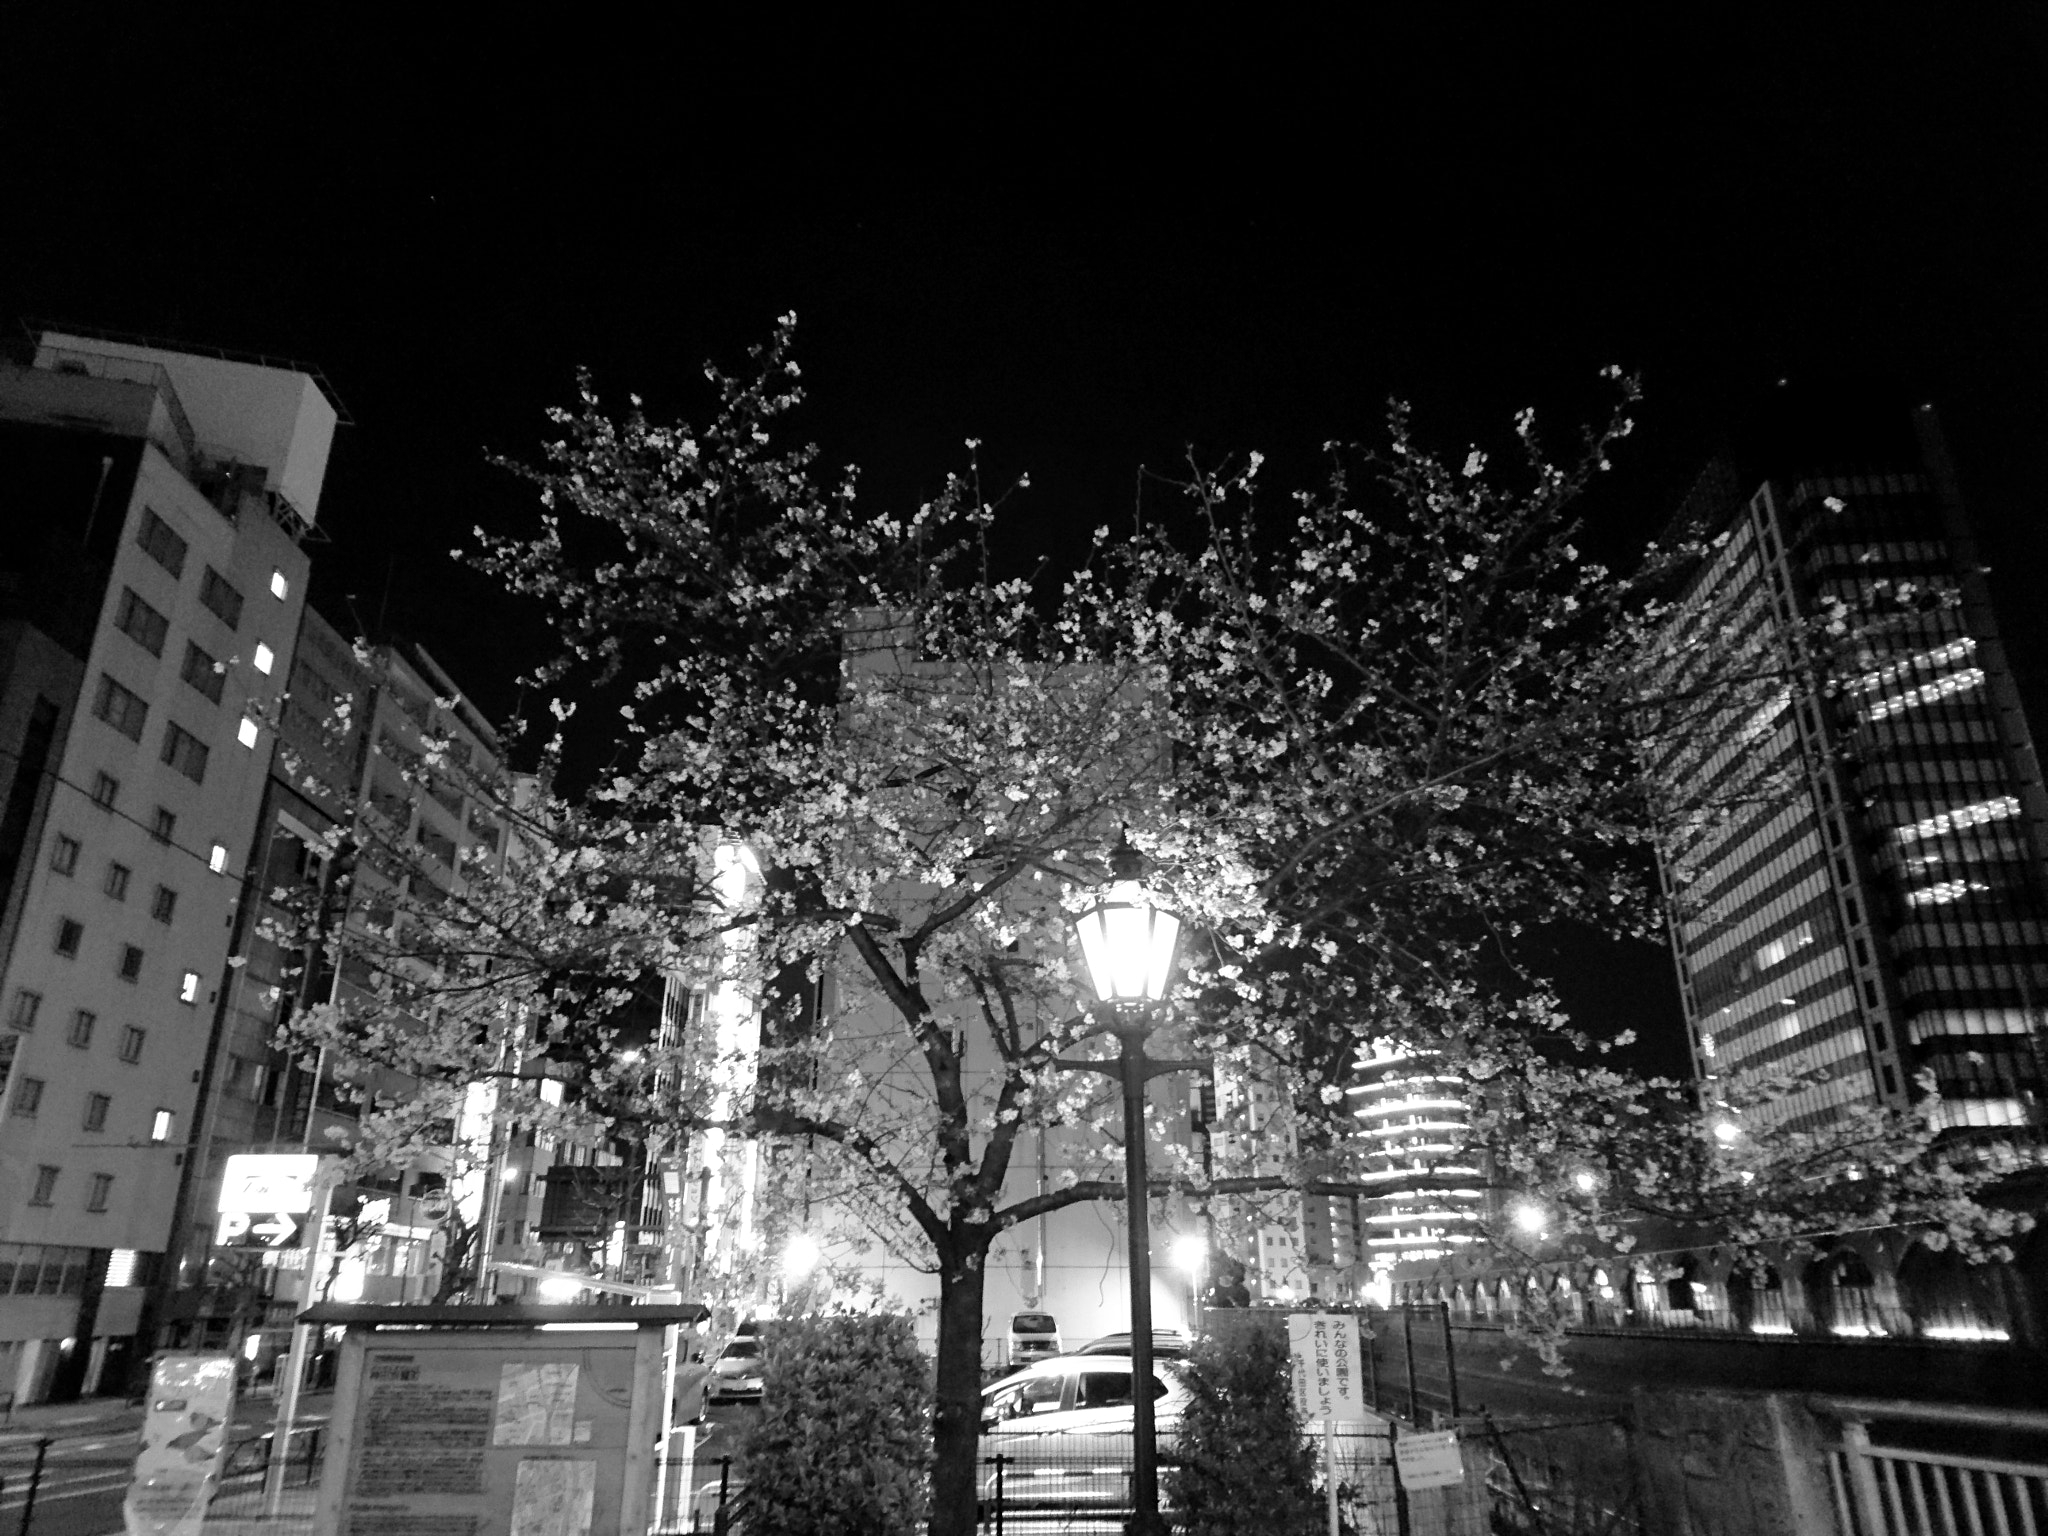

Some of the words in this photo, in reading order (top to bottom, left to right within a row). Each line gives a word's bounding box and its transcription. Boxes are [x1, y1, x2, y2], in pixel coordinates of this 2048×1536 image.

[215, 1212, 251, 1246] P
[1314, 1320, 1332, 1415] きれいに使いましょう
[1332, 1320, 1350, 1400] みんなの公園です。
